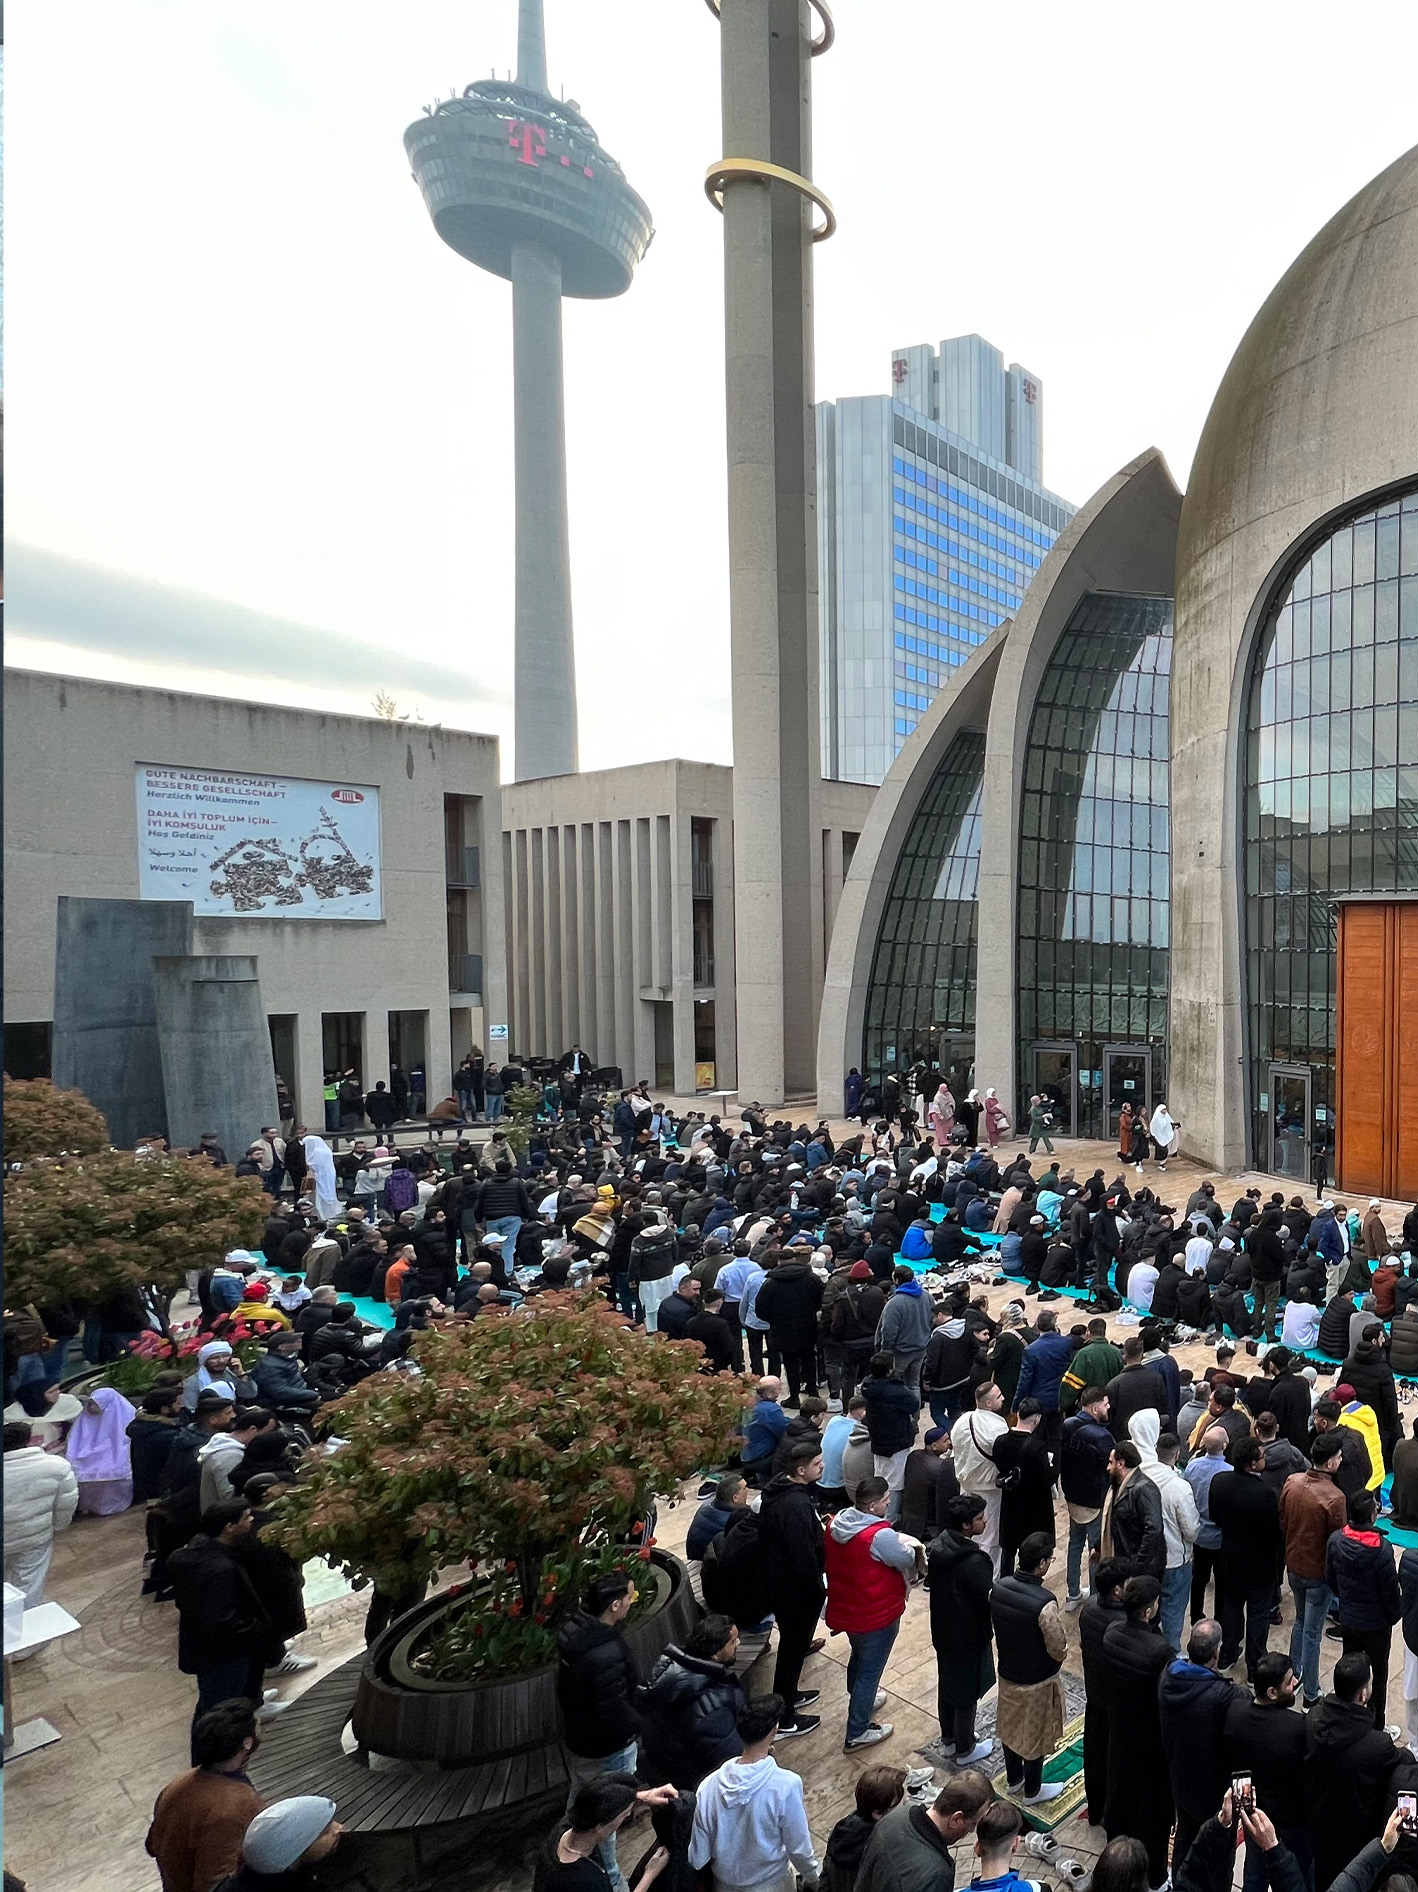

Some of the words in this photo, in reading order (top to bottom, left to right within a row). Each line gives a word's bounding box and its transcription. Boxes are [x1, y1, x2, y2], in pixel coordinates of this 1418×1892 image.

[146, 770, 177, 780] GUTE
[180, 773, 277, 788] NACHBARSCHAFT
[147, 780, 200, 791] BESSERE
[203, 785, 286, 799] GESELLSCHAFT
[147, 790, 192, 800] Herzlich
[195, 794, 260, 806] Willkommen
[148, 809, 180, 819] DAHA
[200, 812, 245, 823] TOPLUM
[172, 831, 215, 841] Geldiniz
[150, 864, 198, 873] Welcome
